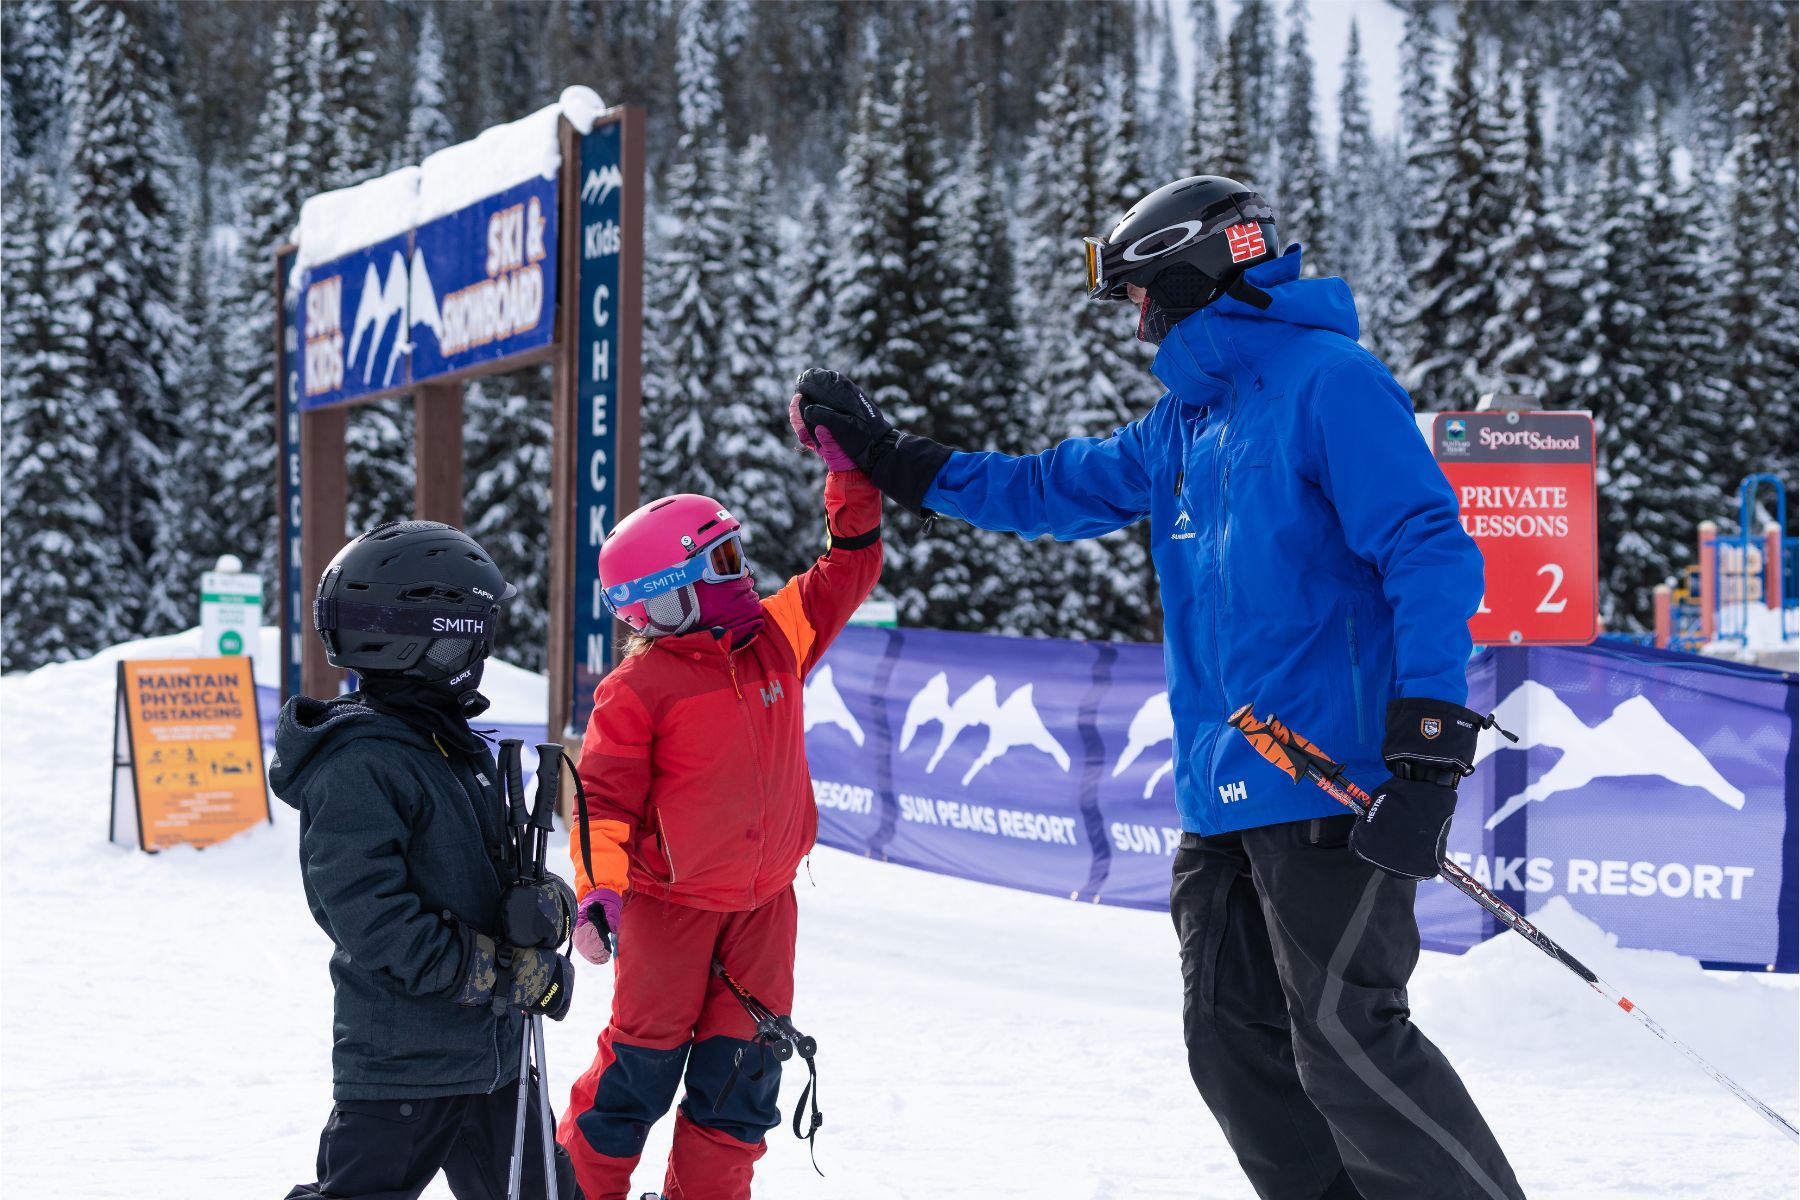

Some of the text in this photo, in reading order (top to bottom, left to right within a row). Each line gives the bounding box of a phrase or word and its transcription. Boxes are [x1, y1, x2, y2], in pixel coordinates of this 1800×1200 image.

[486, 196, 546, 278] SKI &
[584, 219, 621, 260] Kids
[305, 275, 342, 338] SUN
[441, 262, 544, 357] SNOWBOARD
[304, 328, 344, 397] KIDS
[1479, 427, 1581, 450] SportSchool
[1460, 486, 1568, 508] PRIVATE
[1460, 515, 1568, 537] LESSONS
[643, 570, 687, 592] SMITH
[1535, 563, 1568, 613] 2
[472, 587, 494, 601] CAPIX
[432, 618, 484, 634] SMITH
[138, 672, 239, 689] MAINTAIN
[450, 669, 472, 686] CAPIX
[140, 690, 240, 706] PHYSICAL
[142, 706, 243, 721] DISTANCING
[1218, 780, 1248, 804] HH
[899, 794, 1077, 846] SUN PEAKS RESORT
[1366, 793, 1387, 823] HESTRA
[1110, 822, 1161, 855] SUN
[1567, 858, 1755, 900] RESORT
[540, 982, 560, 1008] KOMBI
